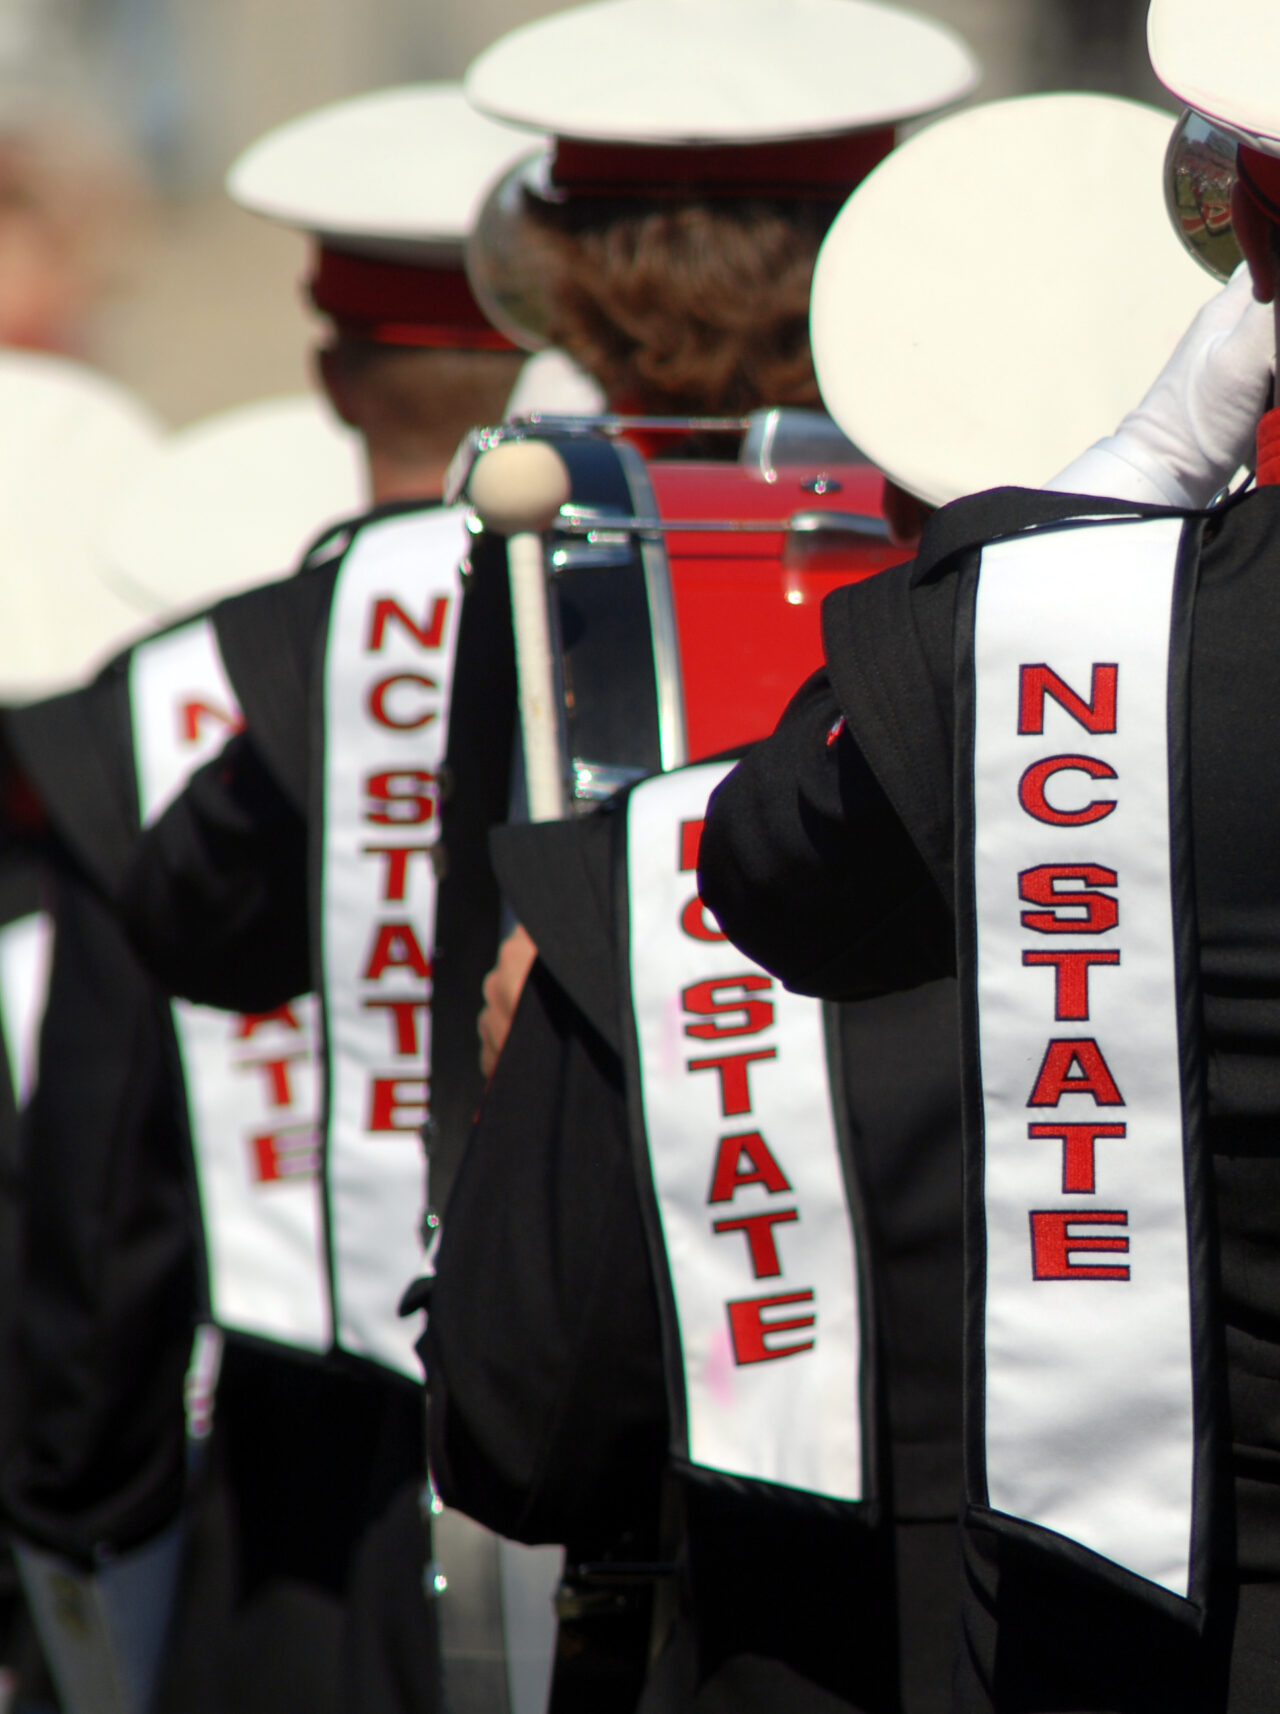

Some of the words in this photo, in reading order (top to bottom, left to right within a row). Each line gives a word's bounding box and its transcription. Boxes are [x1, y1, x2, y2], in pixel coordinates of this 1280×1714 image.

[365, 597, 449, 731] NC
[1017, 662, 1119, 828] NC
[363, 770, 436, 1132] STATE
[1018, 862, 1130, 1281] STATE
[680, 972, 817, 1367] STATE
